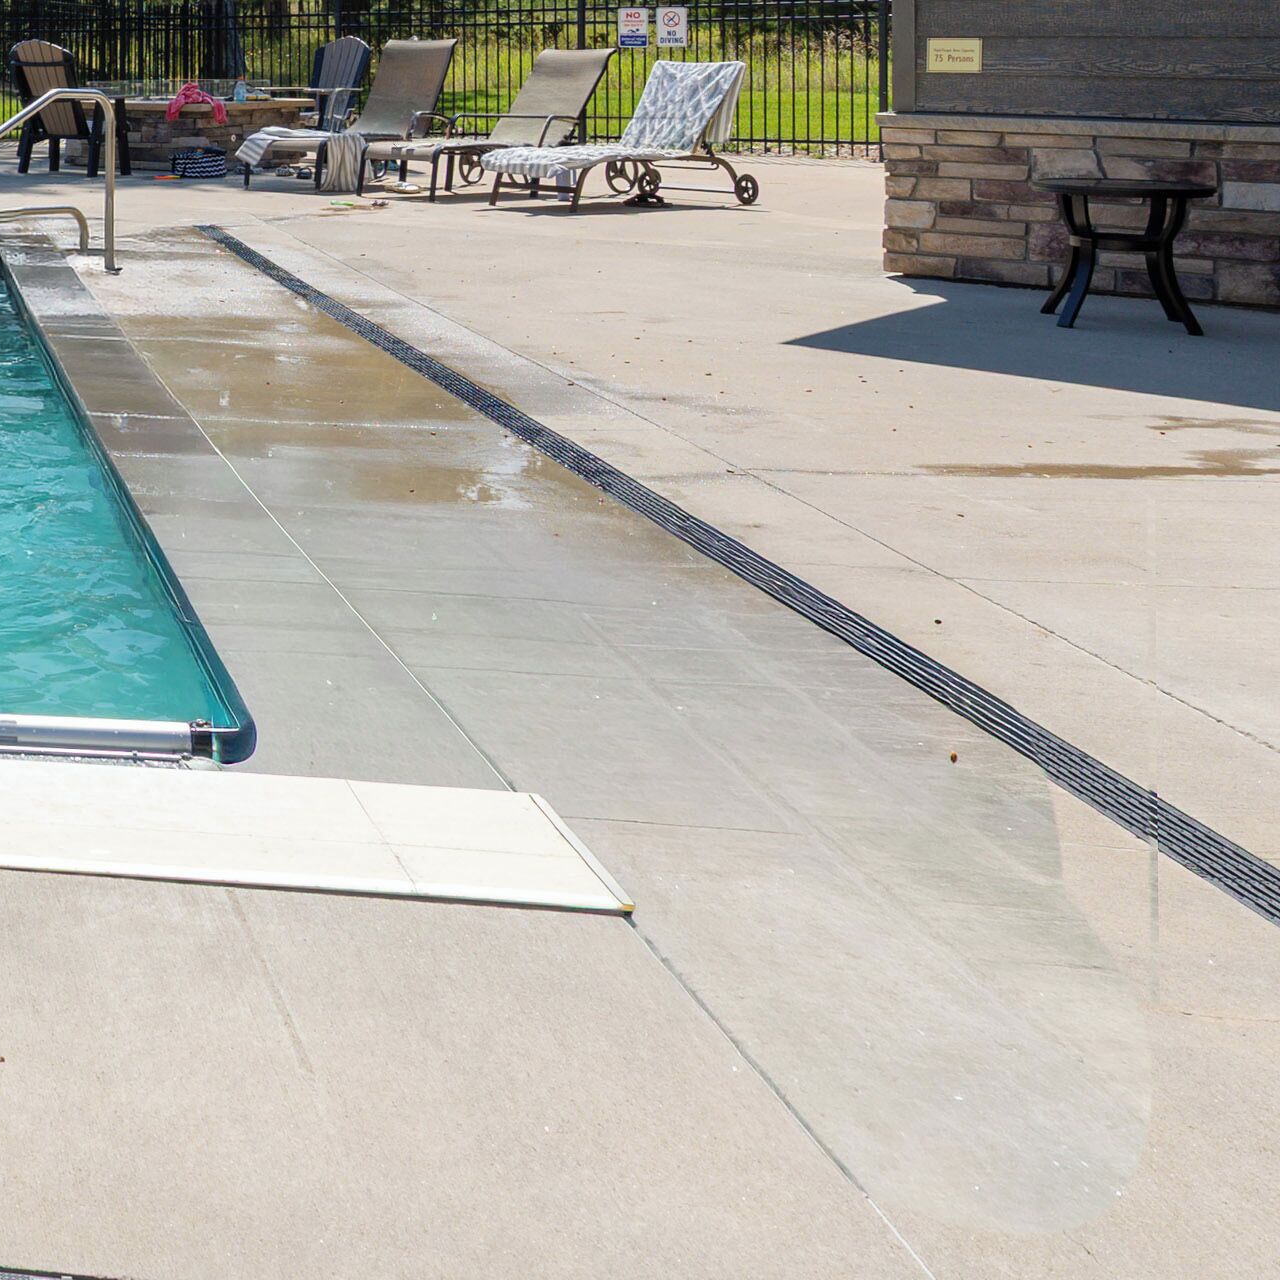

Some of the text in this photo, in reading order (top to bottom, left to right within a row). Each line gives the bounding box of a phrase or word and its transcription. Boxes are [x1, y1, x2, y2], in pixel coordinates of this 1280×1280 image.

[626, 11, 641, 19] NO
[934, 53, 974, 63] 75 Persons
